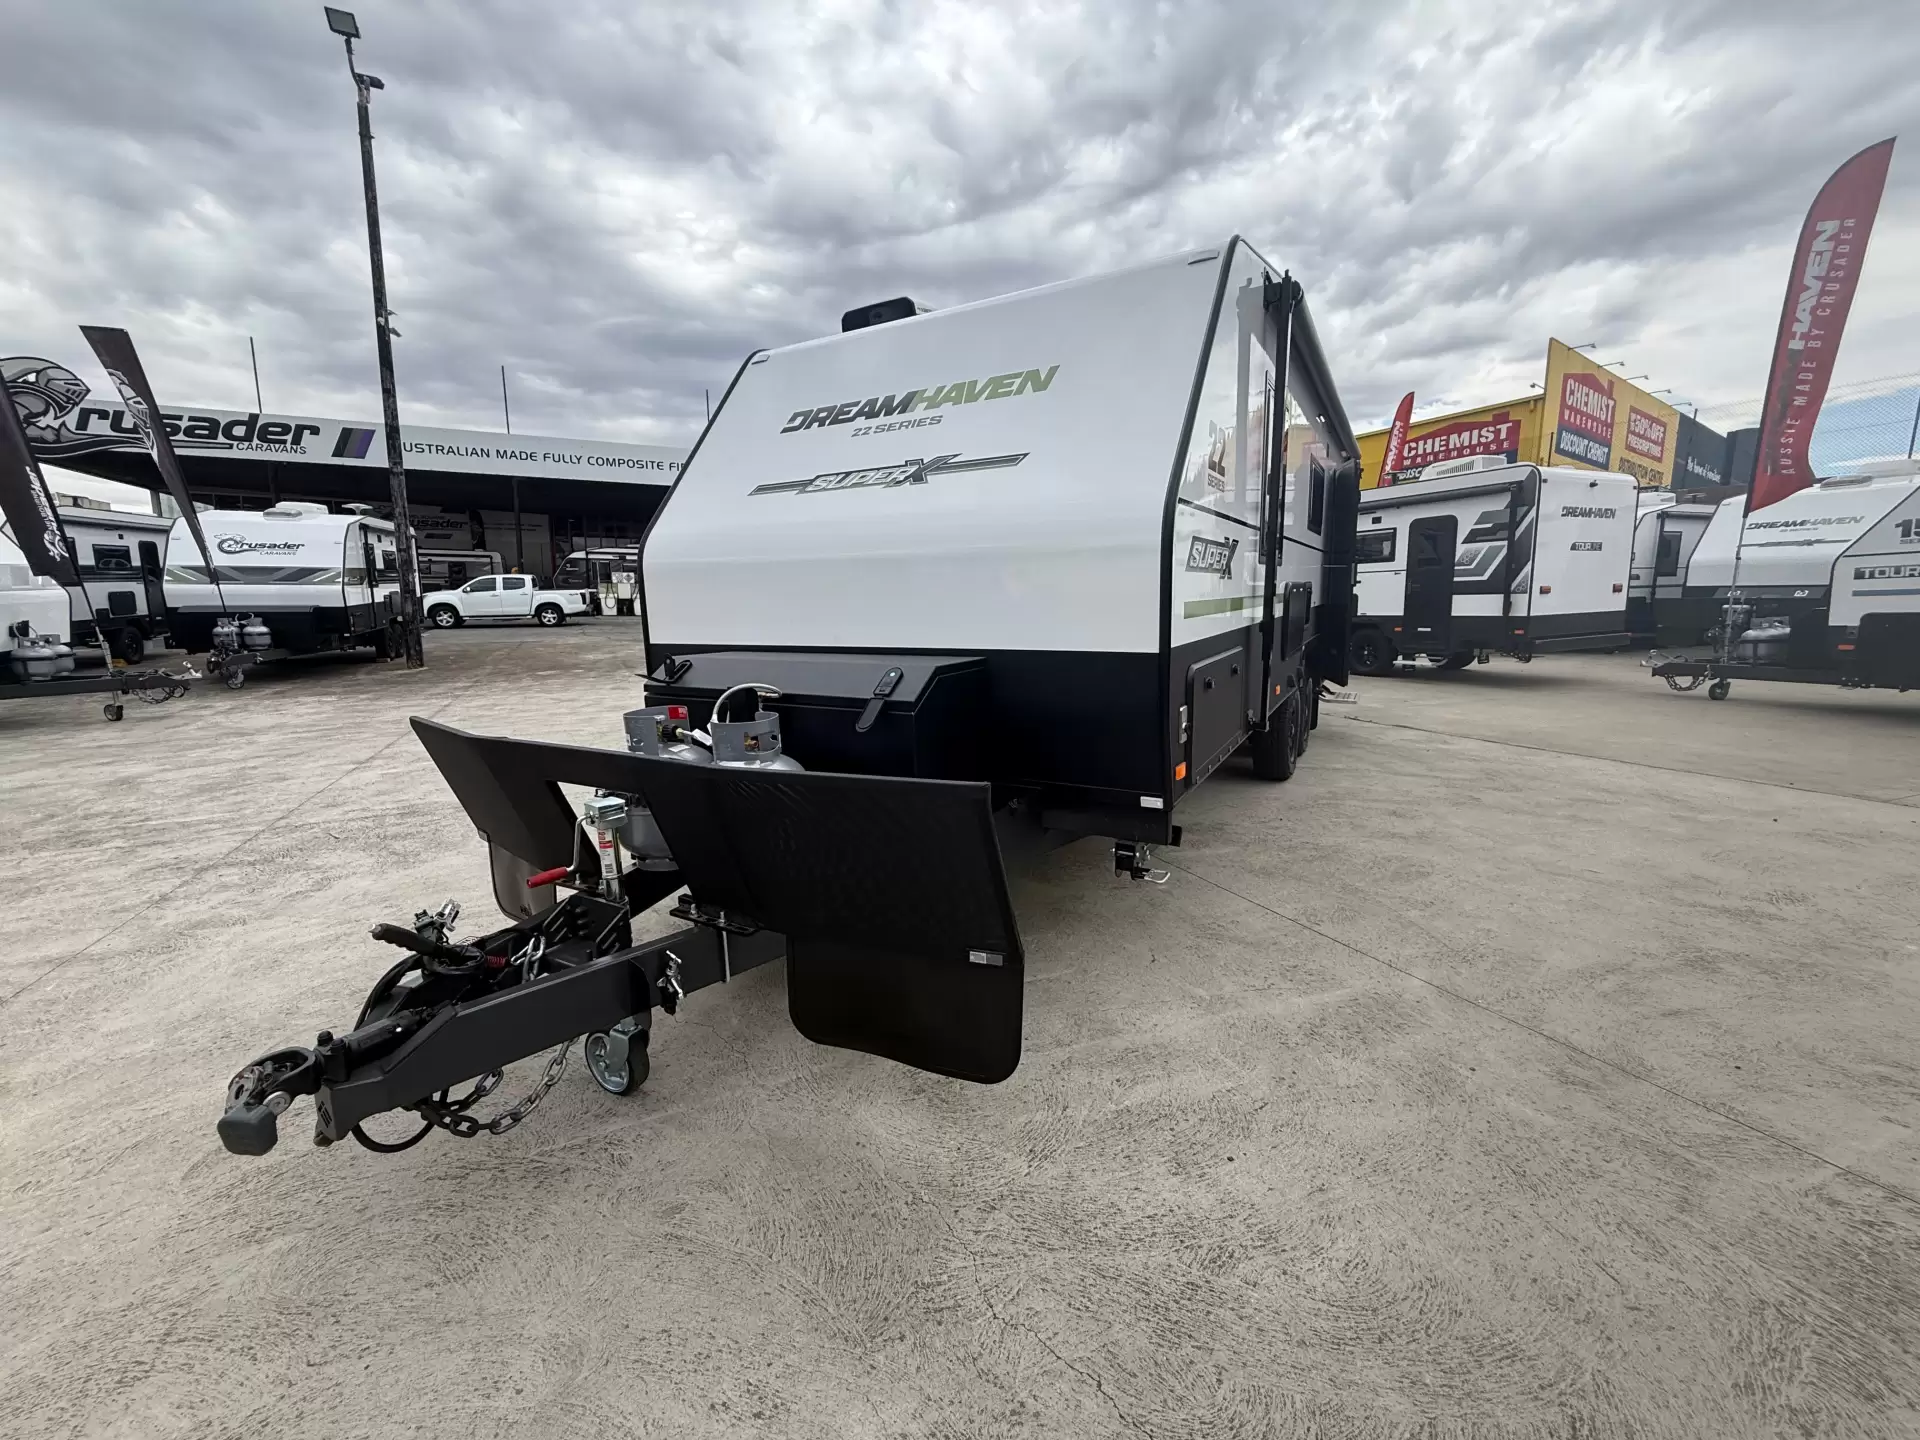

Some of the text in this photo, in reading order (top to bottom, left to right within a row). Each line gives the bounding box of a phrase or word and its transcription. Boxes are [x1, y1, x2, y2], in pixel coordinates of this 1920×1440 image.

[1780, 218, 1856, 475] AUSSIE MADE BY CRUSADER
[780, 365, 1061, 434] DREAMHAVEN
[1565, 378, 1614, 424] CHEMIST
[851, 415, 943, 438] 22 SERIES
[1402, 422, 1513, 458] CHEMIST
[236, 441, 308, 455] CARAVANS
[402, 442, 491, 458] USTRALIAN
[496, 449, 539, 462] MADE
[543, 452, 583, 465] FULLY
[587, 456, 665, 471] COMPOSITE
[1403, 440, 1511, 467] WAREHOUSE
[1560, 430, 1609, 464] DISCOUNT CHEMIST
[1207, 473, 1226, 493] SERIES
[1560, 505, 1617, 519] DREAMHAVEN
[1746, 516, 1865, 531] DREAMHAVEN
